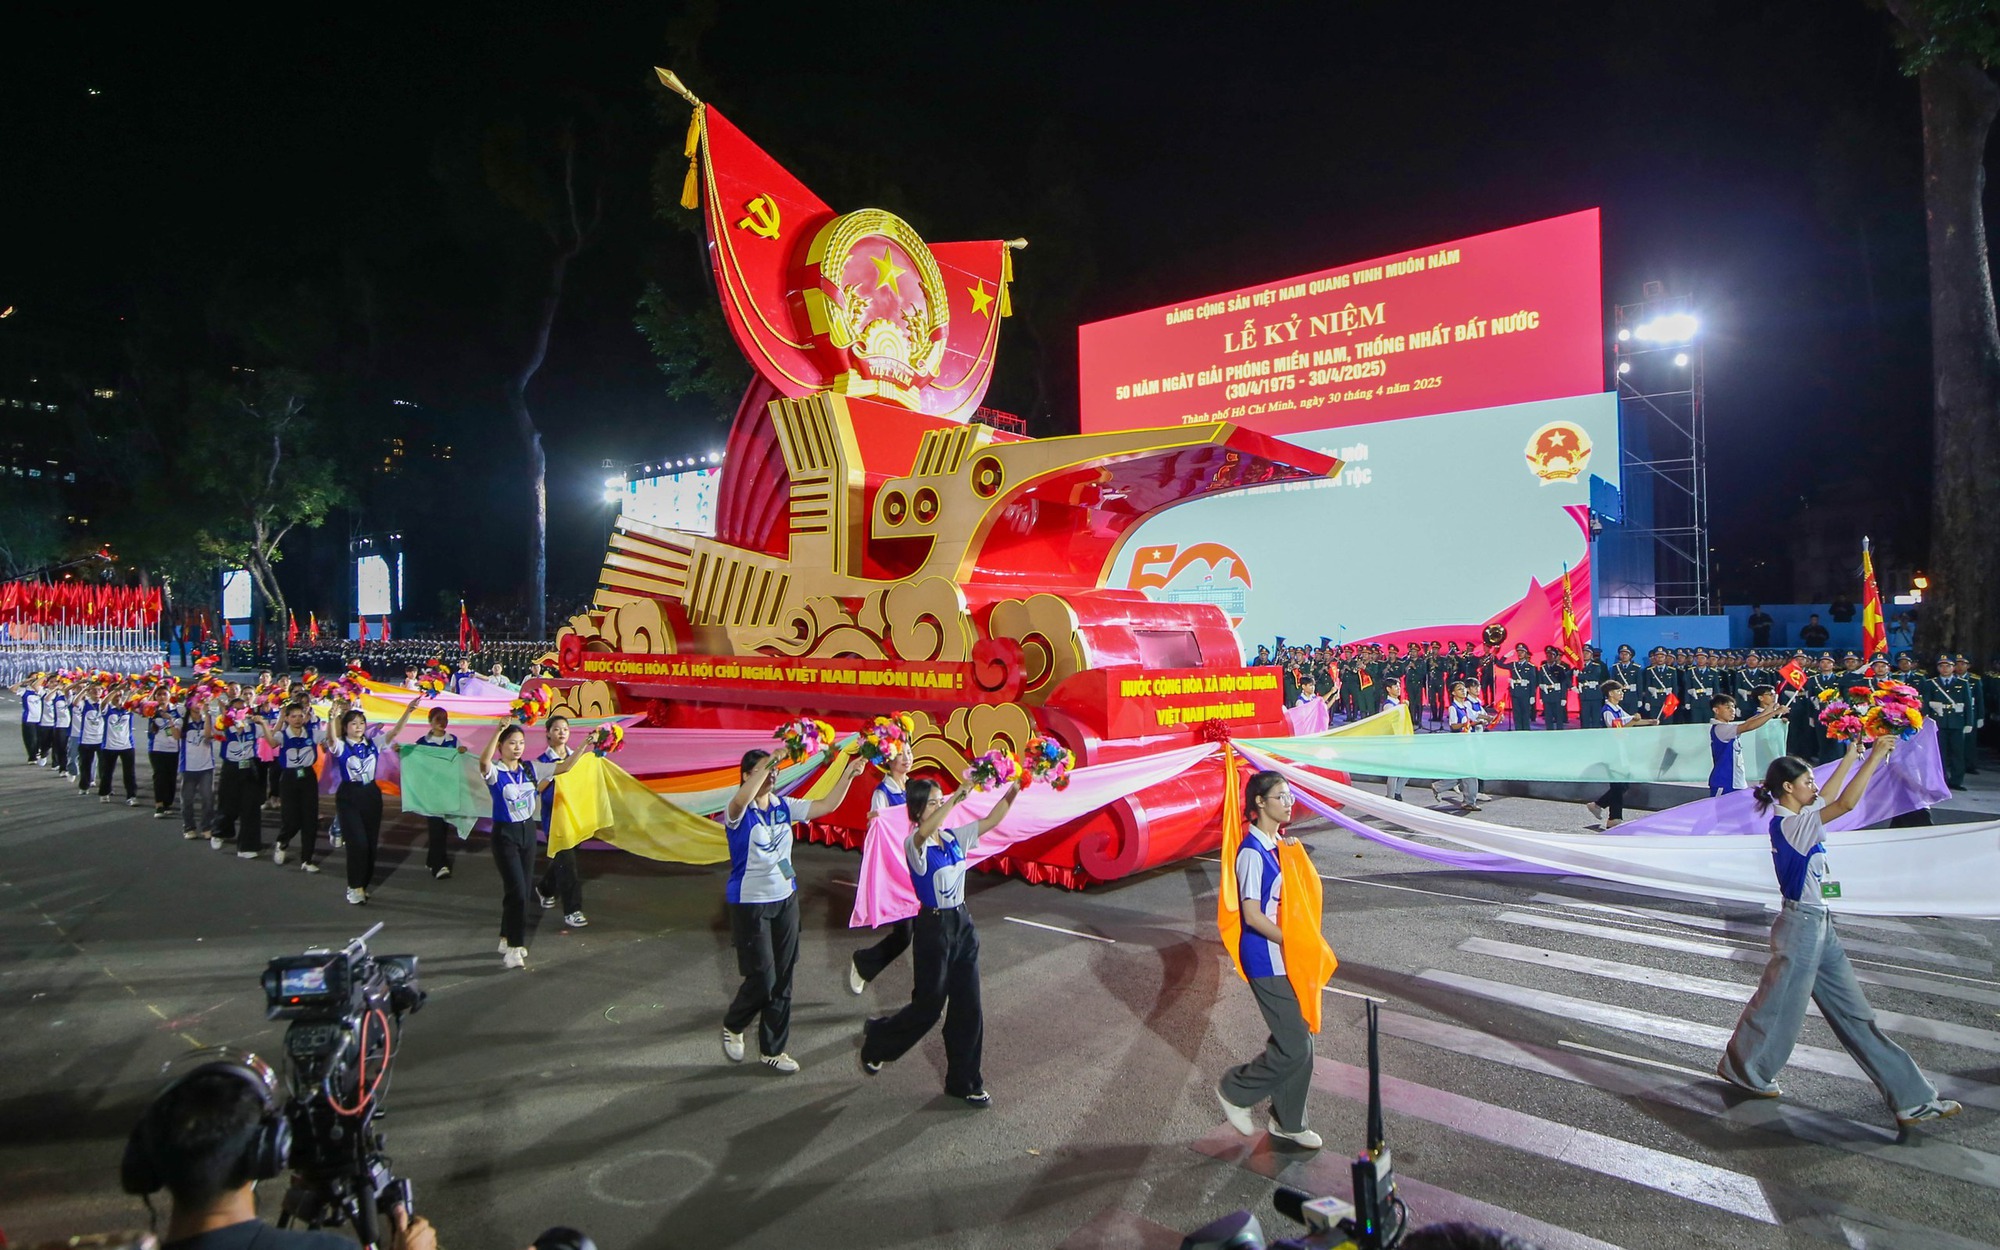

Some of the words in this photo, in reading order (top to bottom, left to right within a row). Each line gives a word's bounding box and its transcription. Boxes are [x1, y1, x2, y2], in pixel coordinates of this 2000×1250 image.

[1166, 307, 1194, 325] ĐẢNG
[1196, 302, 1225, 320] CỘNG
[1227, 294, 1250, 312] SẢN
[1253, 289, 1276, 308] VIỆT
[1279, 283, 1306, 300] NAM
[1309, 274, 1350, 295] QUANG
[1352, 267, 1382, 285] VINH
[1385, 257, 1425, 278] MUÔN
[1428, 249, 1460, 270] NĂM
[1224, 319, 1257, 353] LỄ
[1264, 313, 1302, 347] KỶ
[1309, 302, 1386, 337] NIỆM
[1116, 385, 1130, 400] 50
[1133, 379, 1159, 397] NĂM
[1162, 373, 1194, 392] NGÀY
[1197, 365, 1223, 387] GIẢI
[1225, 359, 1270, 381] PHÓNG
[1274, 350, 1309, 372] MIỀN
[1313, 346, 1351, 366] NAM,
[1355, 333, 1405, 359] THỐNG
[1409, 323, 1451, 350] NHẤT
[1455, 316, 1487, 342] ĐẤT
[1491, 309, 1540, 336] NƯỚC
[892, 369, 913, 387] NAM
[1225, 374, 1296, 401] (30/4/1975
[1308, 359, 1386, 387] 30/4/2025)
[1182, 414, 1209, 425] Thành
[1211, 407, 1230, 423] phố
[1231, 404, 1246, 418] Hồ
[1248, 401, 1266, 415] Chí
[1268, 399, 1297, 414] Minh,
[1300, 394, 1325, 411] ngày
[1328, 393, 1342, 405] 30
[1344, 388, 1373, 402] tháng
[1376, 385, 1384, 396] 4
[1386, 382, 1410, 396] năm
[1413, 376, 1443, 391] 2025
[1345, 466, 1372, 488] TỘC
[584, 658, 614, 673] NƯỚC
[614, 659, 643, 675] CỘNG
[644, 660, 669, 675] HÒA
[671, 661, 689, 677] XÃ
[691, 662, 714, 679] HỘI
[715, 661, 740, 679] CHỦ
[742, 664, 784, 681] NGHĨA
[785, 666, 818, 685] VIỆT
[821, 669, 857, 684] NAM
[859, 669, 908, 686] MUÔN
[1121, 675, 1152, 697] NƯỚC
[1153, 676, 1181, 698] CỘNG
[1182, 675, 1203, 693] HÒA
[1205, 674, 1219, 693] XÃ
[1219, 674, 1235, 694] HỘI
[1236, 673, 1252, 691] CHỦ
[1156, 706, 1180, 728] VIỆT
[1181, 706, 1204, 723] NAM
[1205, 702, 1231, 720] MUÔN
